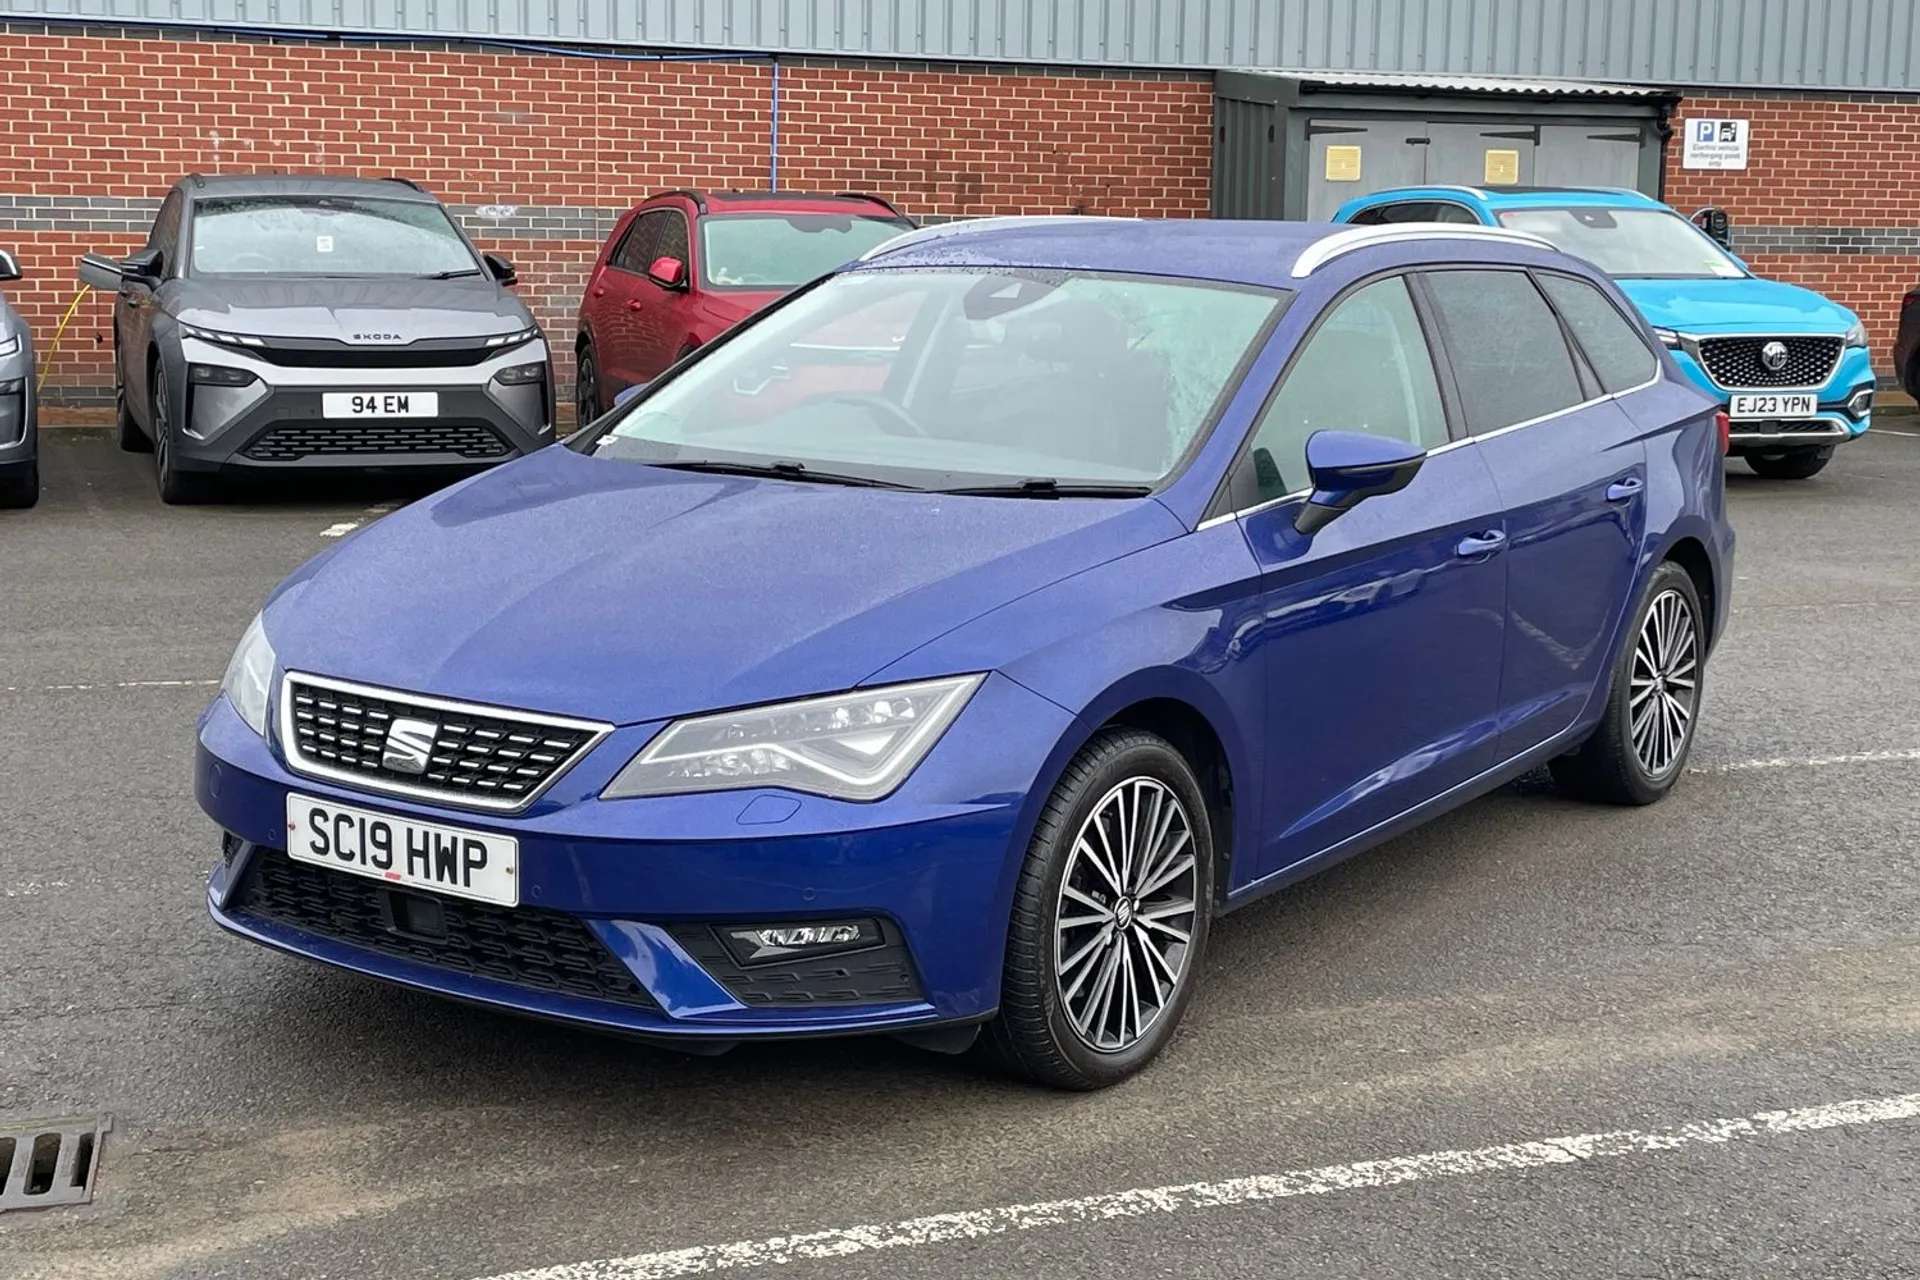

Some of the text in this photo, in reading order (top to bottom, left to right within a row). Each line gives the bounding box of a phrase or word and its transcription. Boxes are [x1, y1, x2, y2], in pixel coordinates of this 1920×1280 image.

[1700, 123, 1712, 141] P
[352, 396, 409, 413] 94 EM
[1737, 397, 1810, 412] EJ23 YPN
[309, 808, 487, 887] SC19 HWP
